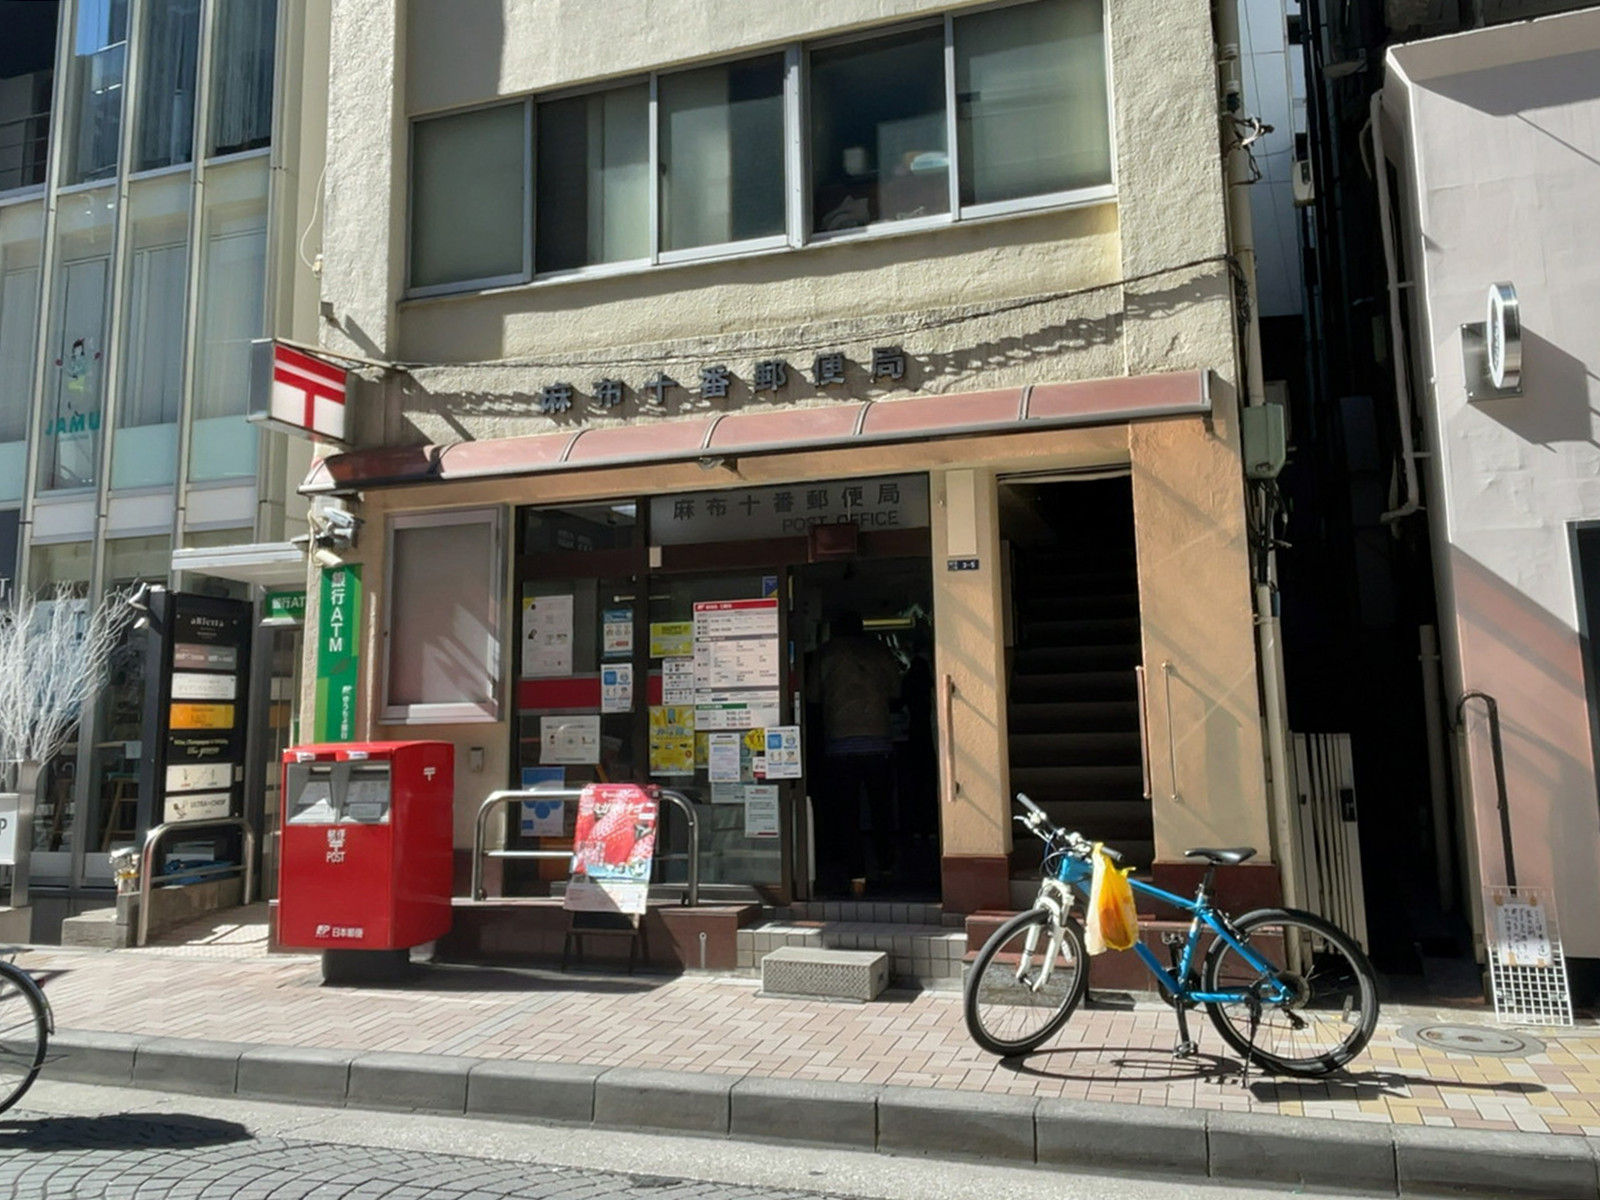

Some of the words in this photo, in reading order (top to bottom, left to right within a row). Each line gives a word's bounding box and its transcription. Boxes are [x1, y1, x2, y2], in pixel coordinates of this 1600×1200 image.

[540, 346, 905, 414] 麻布十番郵便局
[45, 409, 101, 436] JAMU
[672, 483, 900, 521] 麻布十番郵便局
[326, 851, 346, 863] POST
